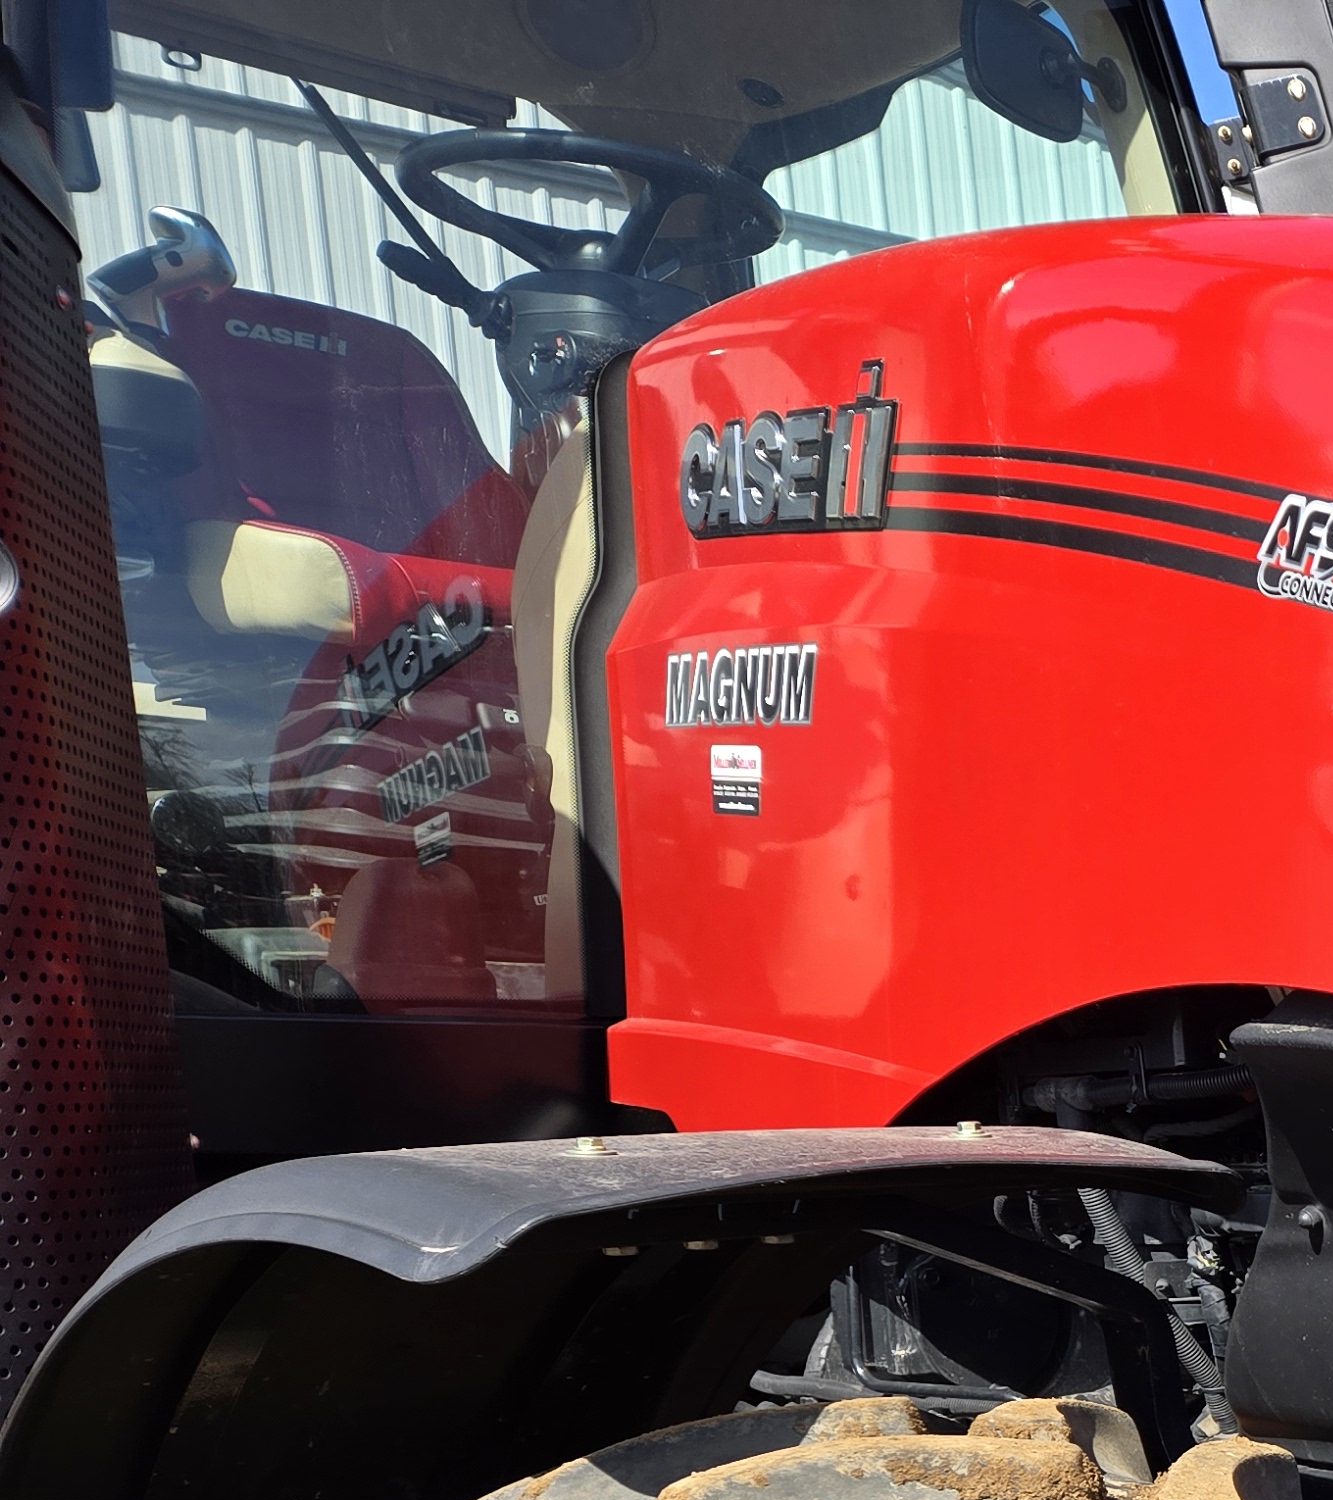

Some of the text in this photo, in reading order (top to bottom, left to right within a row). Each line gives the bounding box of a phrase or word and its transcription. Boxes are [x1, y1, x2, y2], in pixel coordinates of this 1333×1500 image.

[225, 319, 315, 350] CASE
[681, 411, 832, 534] CASE
[666, 644, 817, 727] MAGNUM
